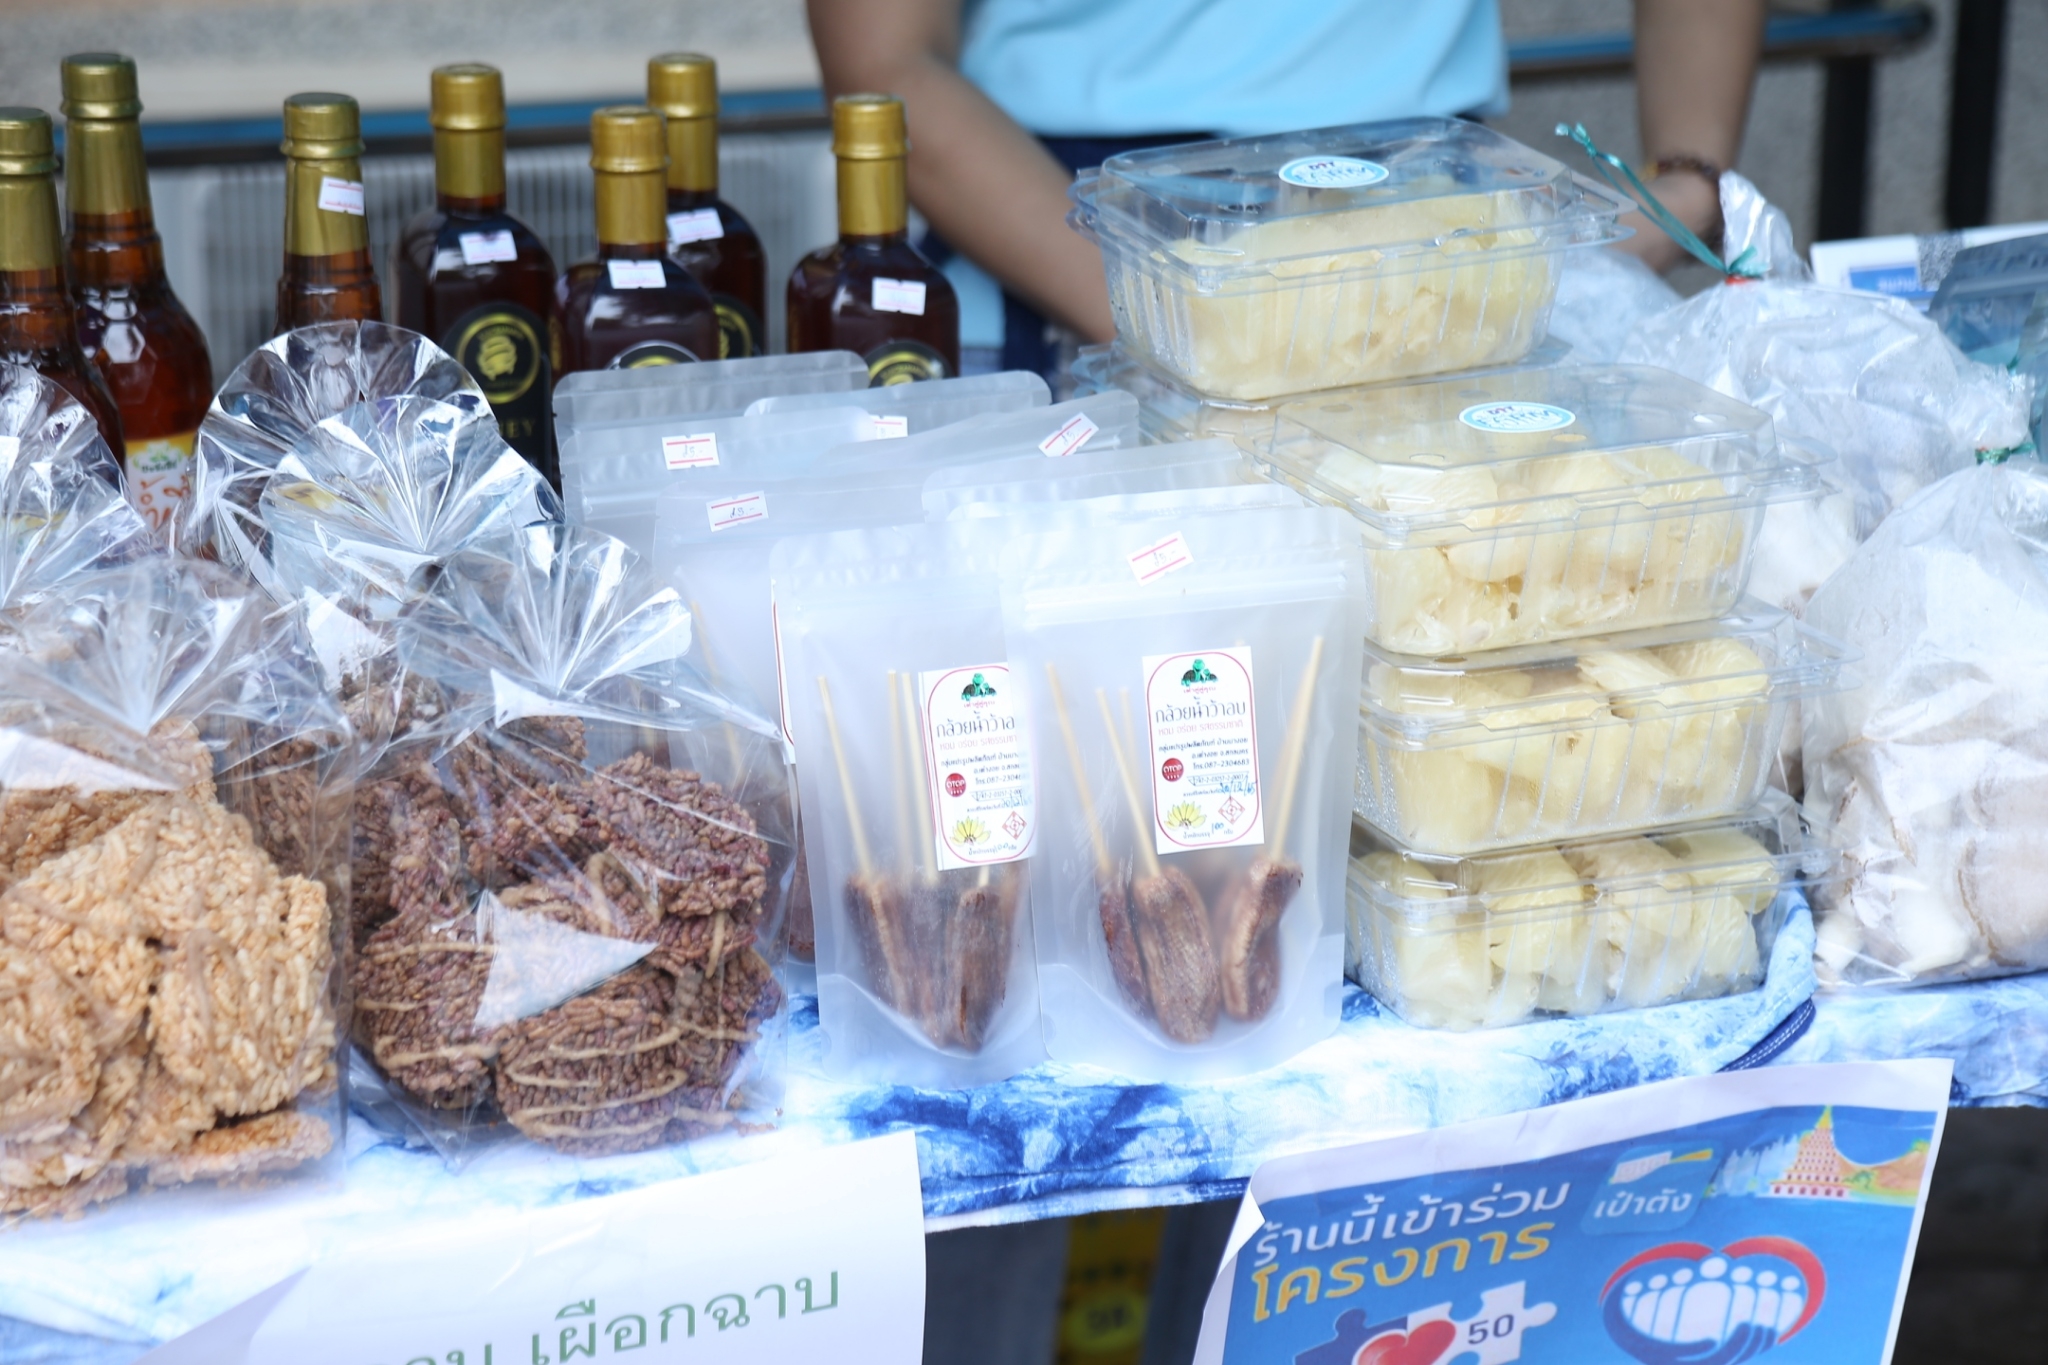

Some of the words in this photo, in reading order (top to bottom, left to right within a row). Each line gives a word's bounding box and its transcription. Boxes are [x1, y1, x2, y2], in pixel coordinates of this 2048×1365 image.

[936, 709, 1016, 738] กล้วยน้ำว้าอ
[1155, 696, 1247, 724] กล้วยน้ำว้าอบ
[1163, 763, 1183, 774] OTOP
[1252, 1182, 1572, 1268] ร้านนี้เข้าร่วม
[1251, 1222, 1556, 1324] โครงการ
[531, 1270, 839, 1365] เผือกฉาบ
[1467, 1313, 1515, 1346] 50
